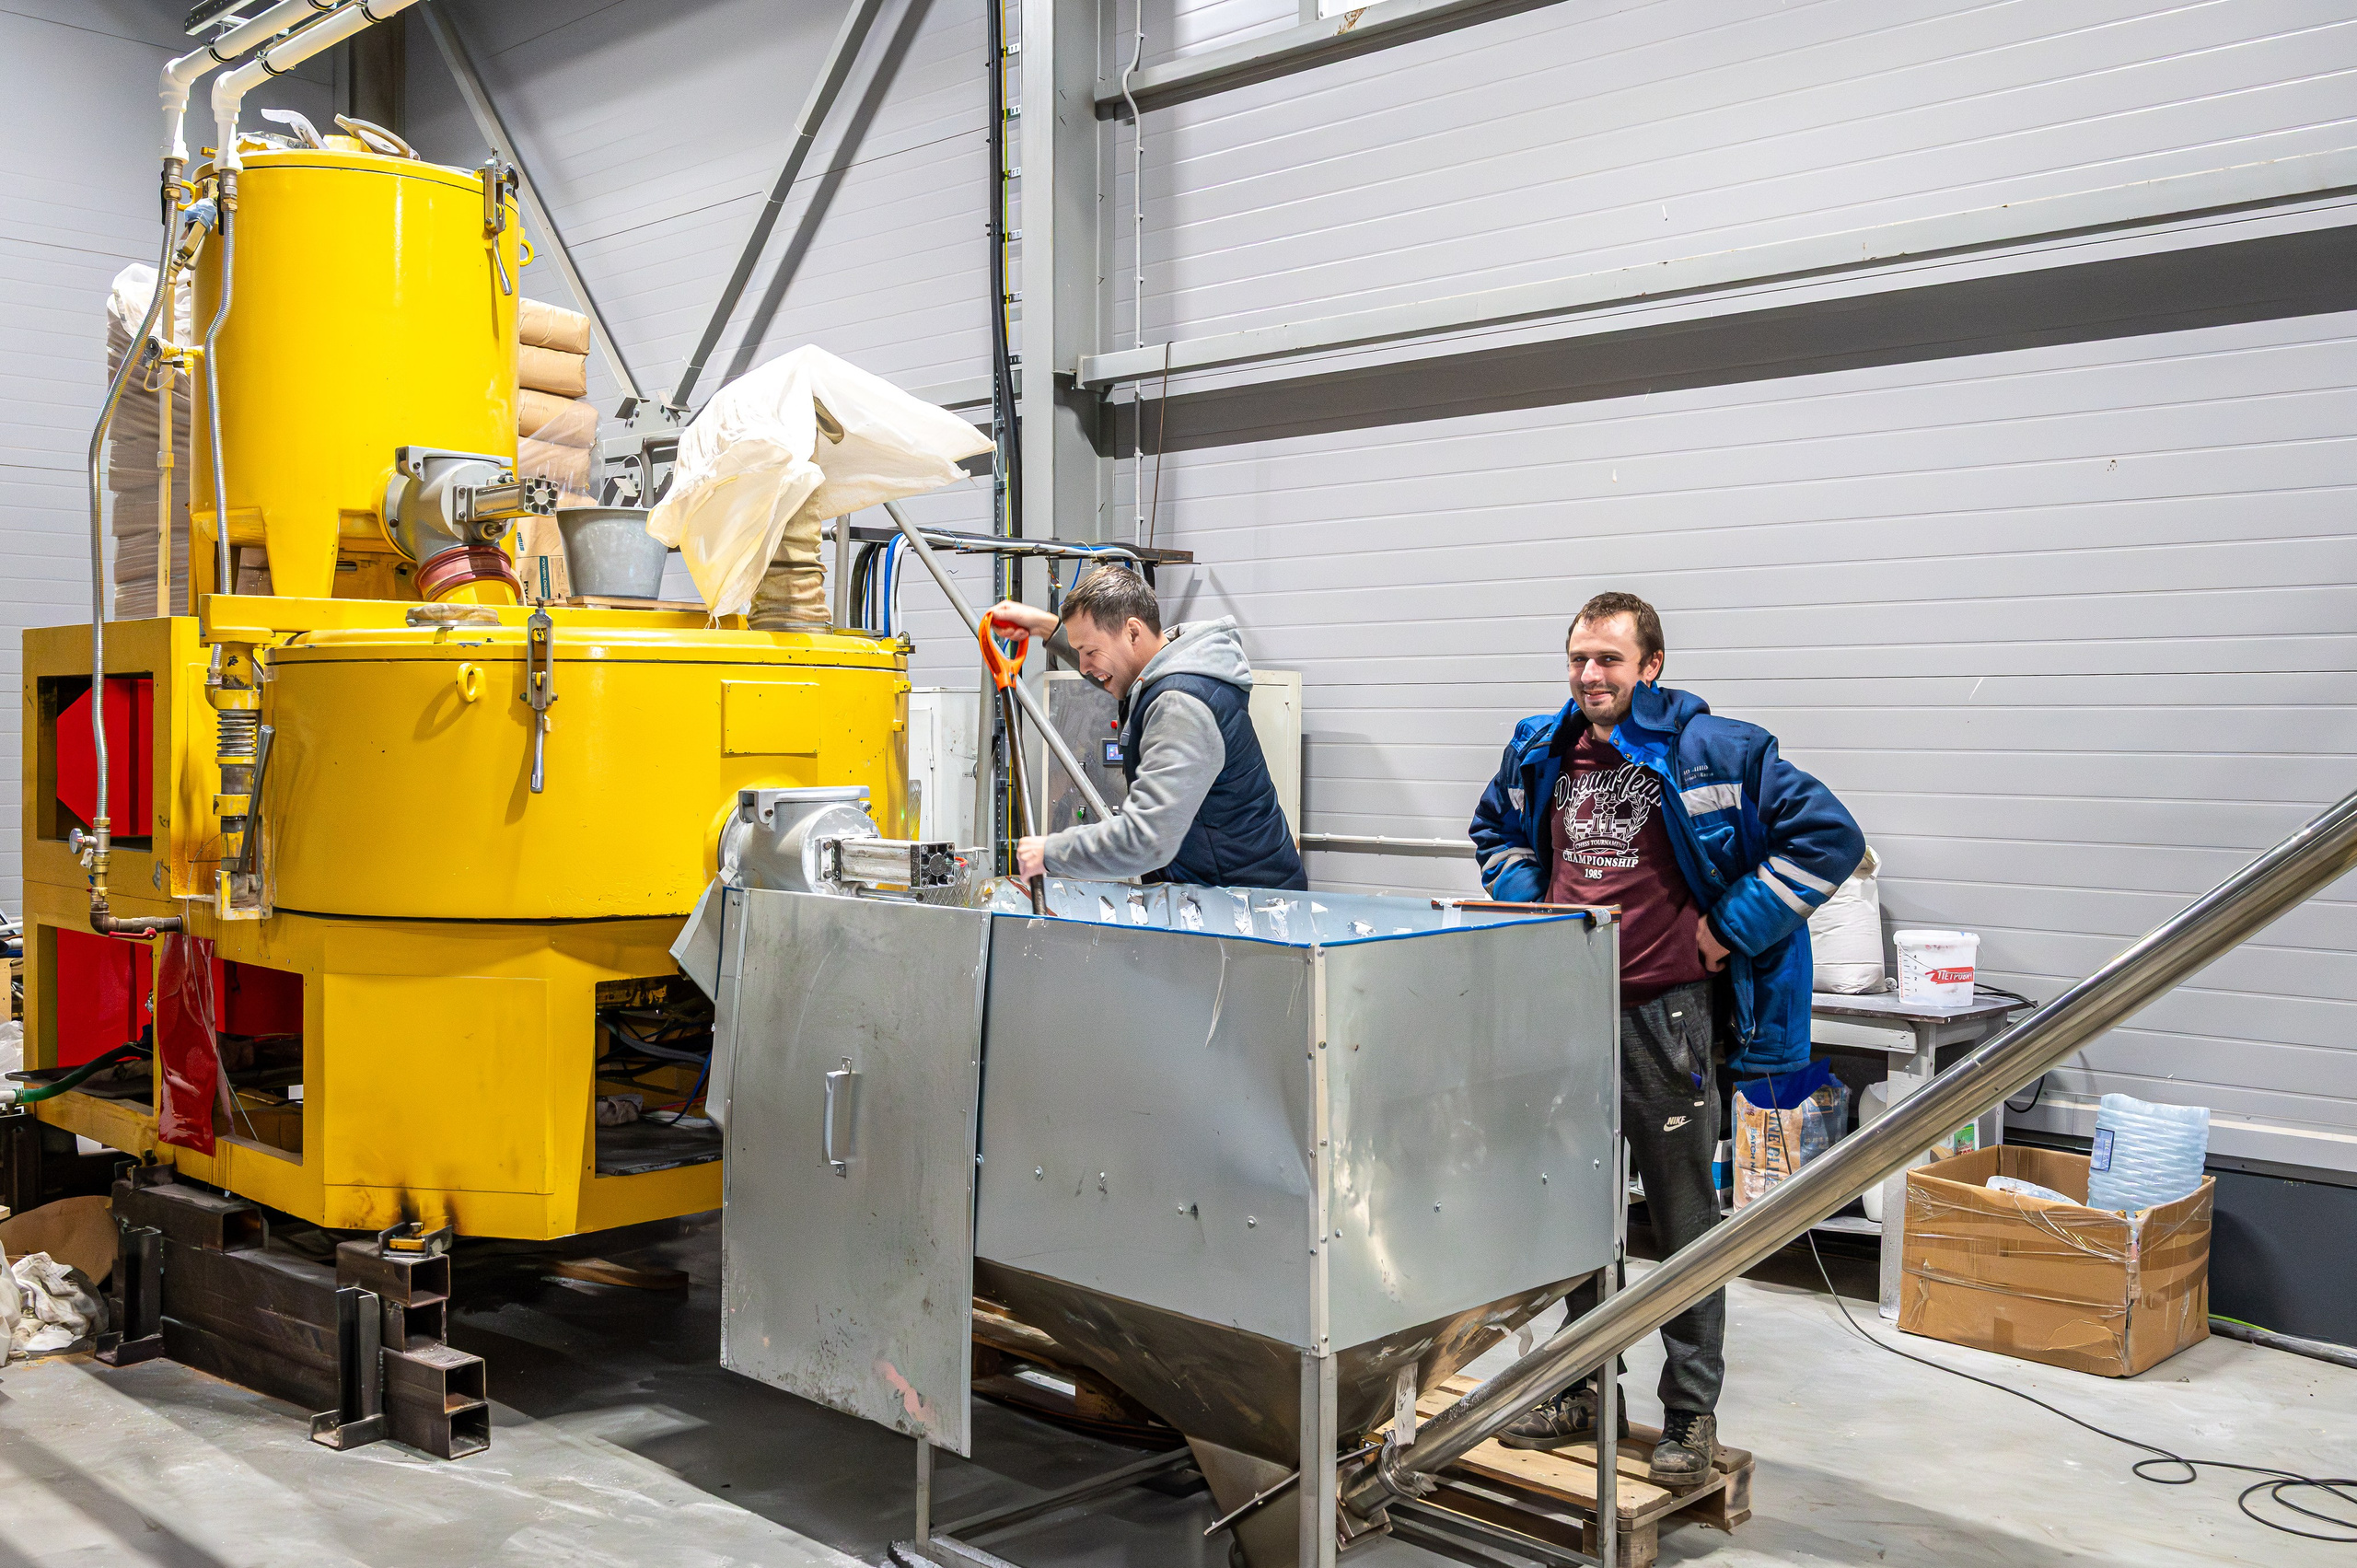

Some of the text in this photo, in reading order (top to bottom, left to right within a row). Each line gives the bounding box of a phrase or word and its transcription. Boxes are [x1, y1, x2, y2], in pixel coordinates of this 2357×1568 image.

[1553, 770, 1619, 811] Dream
[1575, 839, 1627, 850] CHESS TOURNAMENT
[1562, 851, 1639, 868] CHAMPIONSHIP
[1584, 868, 1603, 879] 1985
[1667, 1115, 1686, 1125] NIKE
